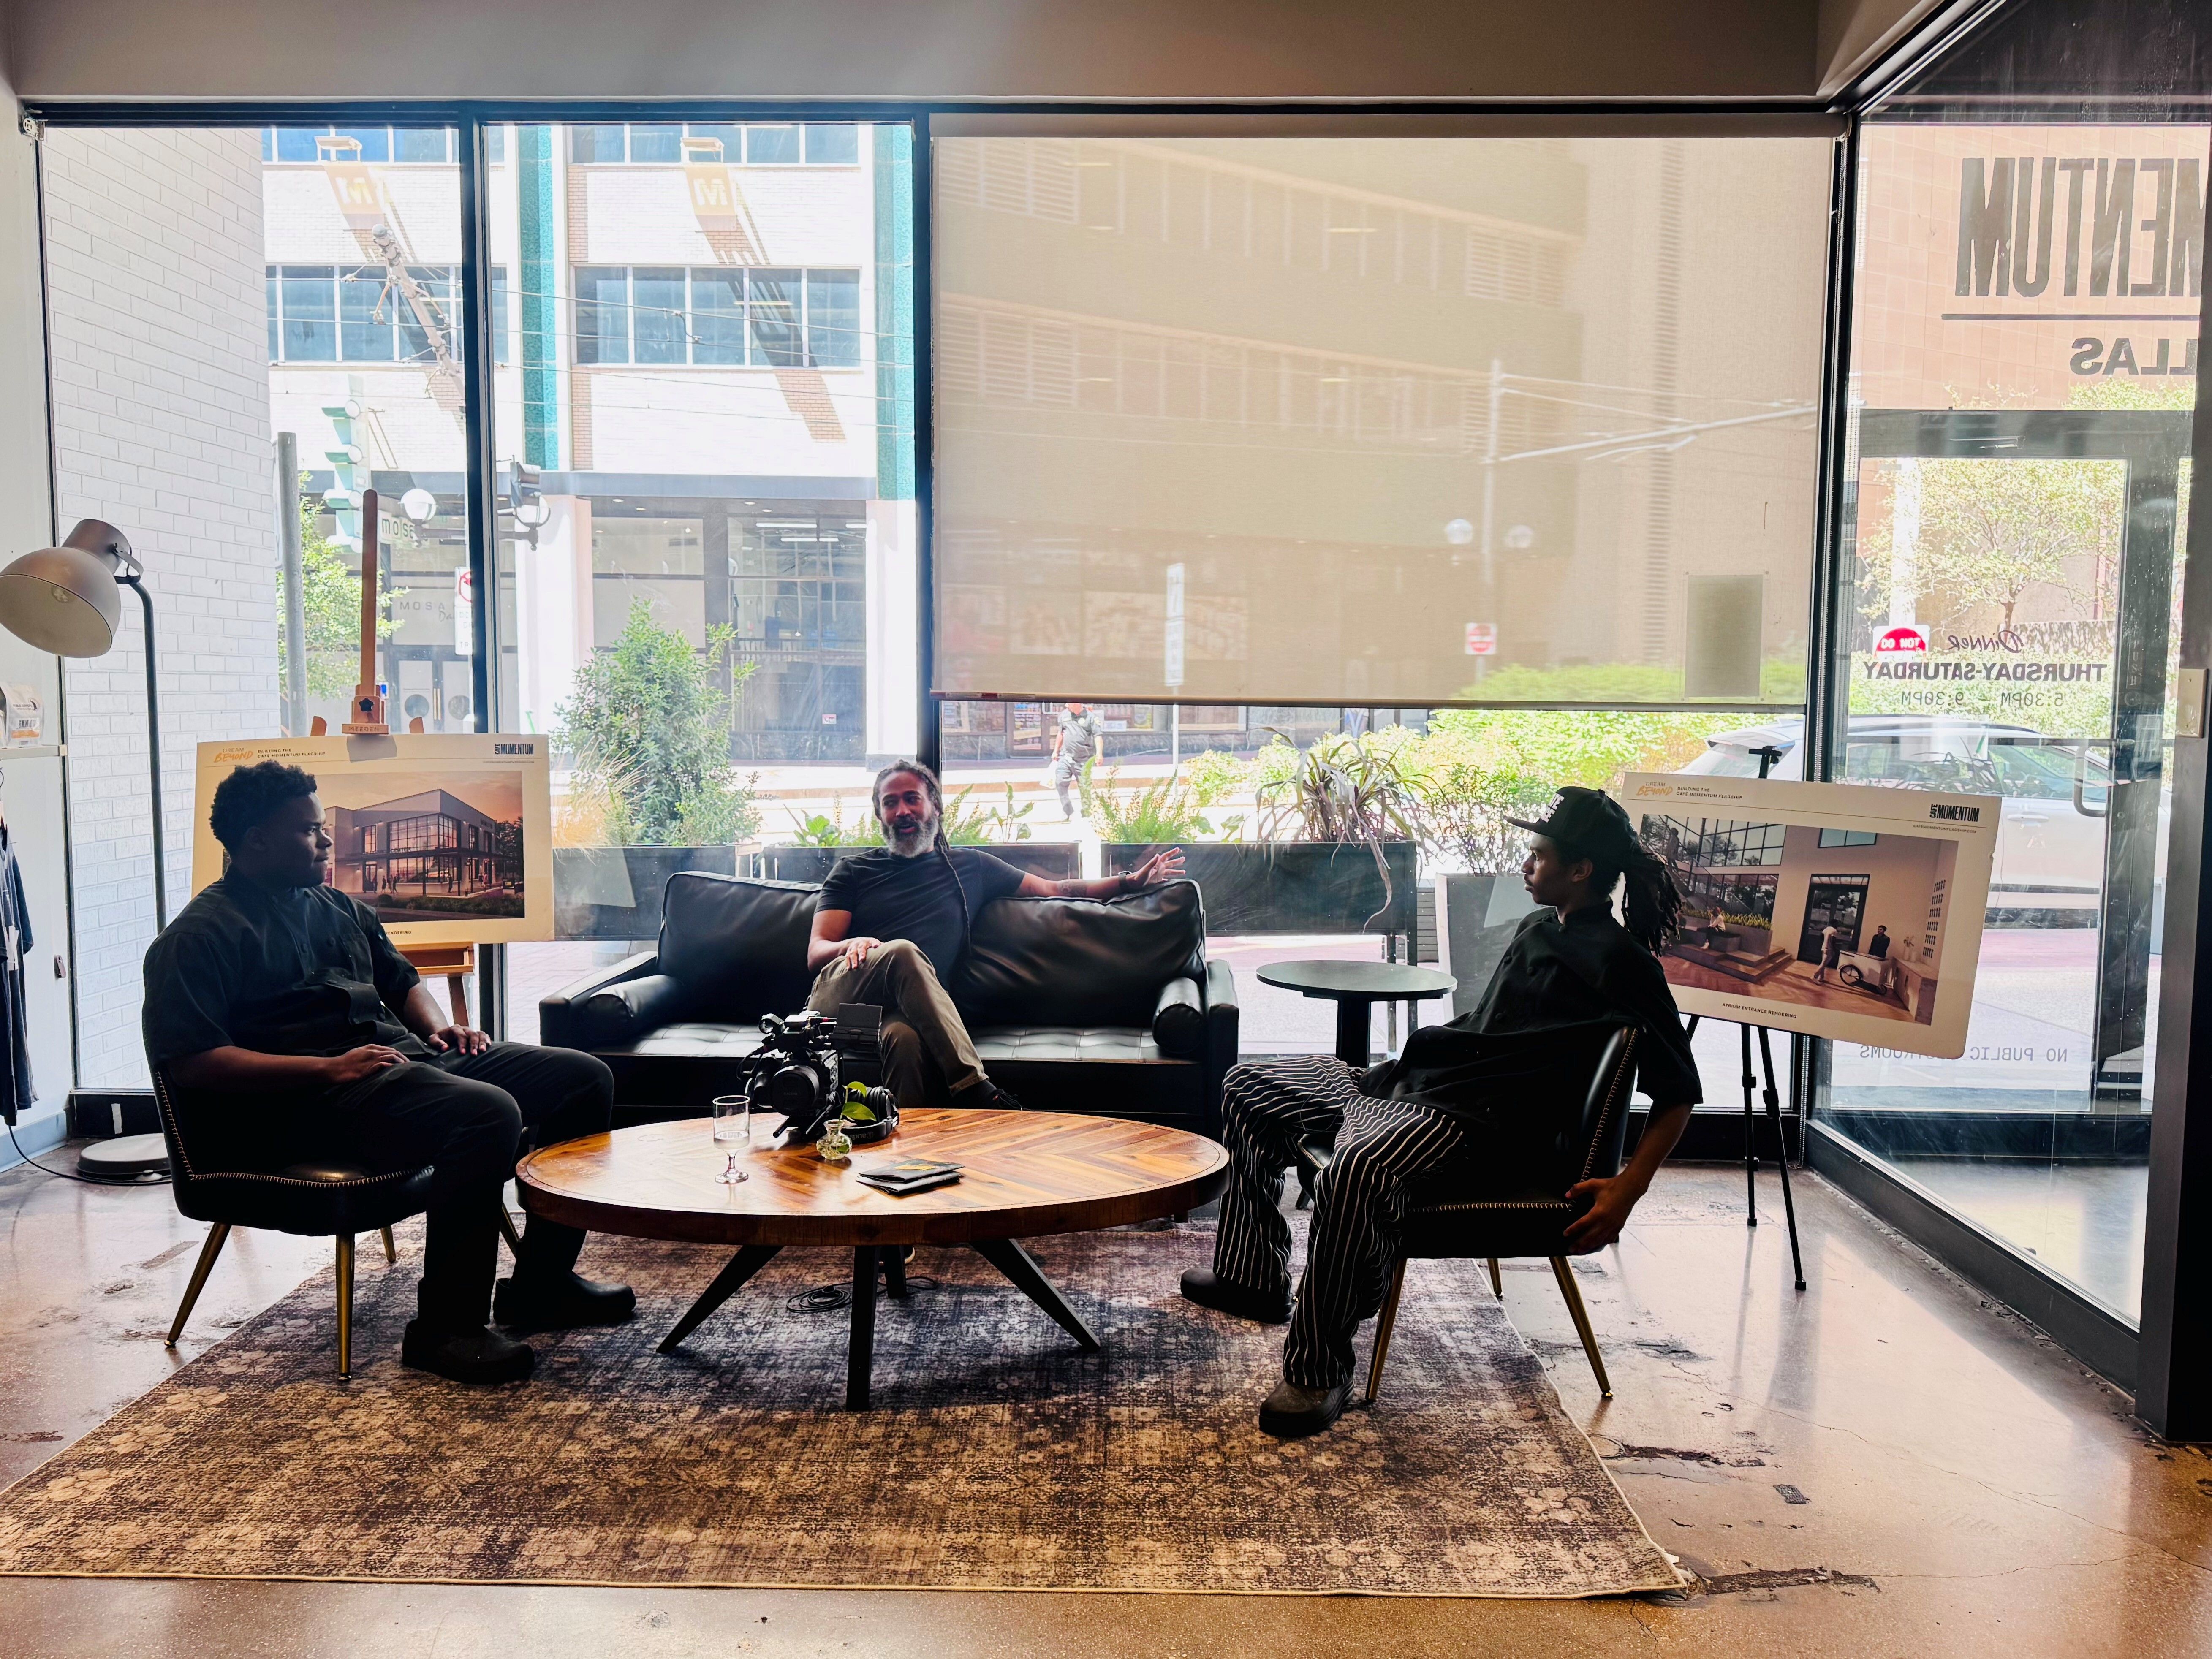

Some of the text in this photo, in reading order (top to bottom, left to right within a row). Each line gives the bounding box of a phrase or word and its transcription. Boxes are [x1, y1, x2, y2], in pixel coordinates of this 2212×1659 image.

[382, 518, 428, 541] mosa
[400, 602, 445, 610] MOSA
[1881, 638, 1921, 649] DO NOT
[500, 744, 534, 755] MOMENTUM
[214, 751, 253, 763] BEYOND
[1636, 785, 1673, 796] BEYOND
[1937, 804, 1980, 822] MOMENTUM
[1768, 1010, 1797, 1018] RENDERING
